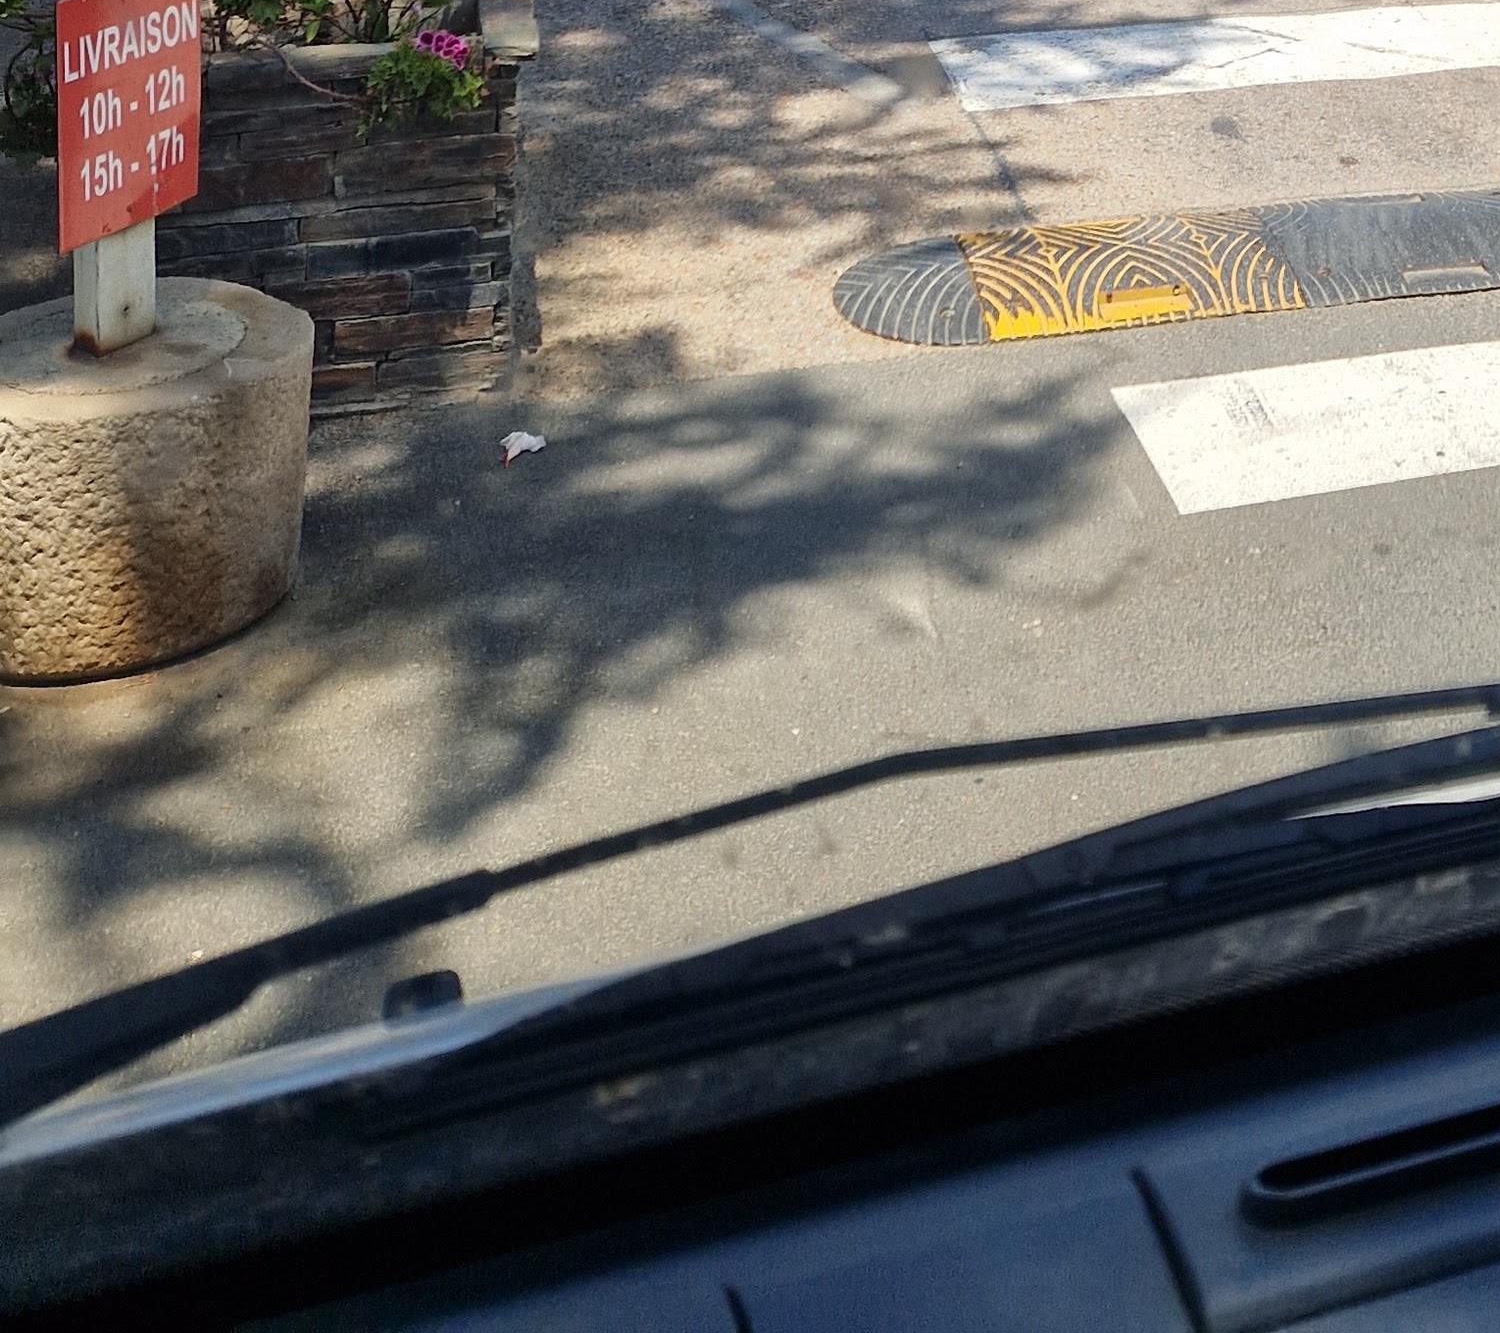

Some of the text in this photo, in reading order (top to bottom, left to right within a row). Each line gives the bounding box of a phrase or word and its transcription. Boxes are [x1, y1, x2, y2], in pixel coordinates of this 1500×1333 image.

[79, 65, 185, 140] 10h - 12h
[80, 125, 185, 202] 15h - 17h
